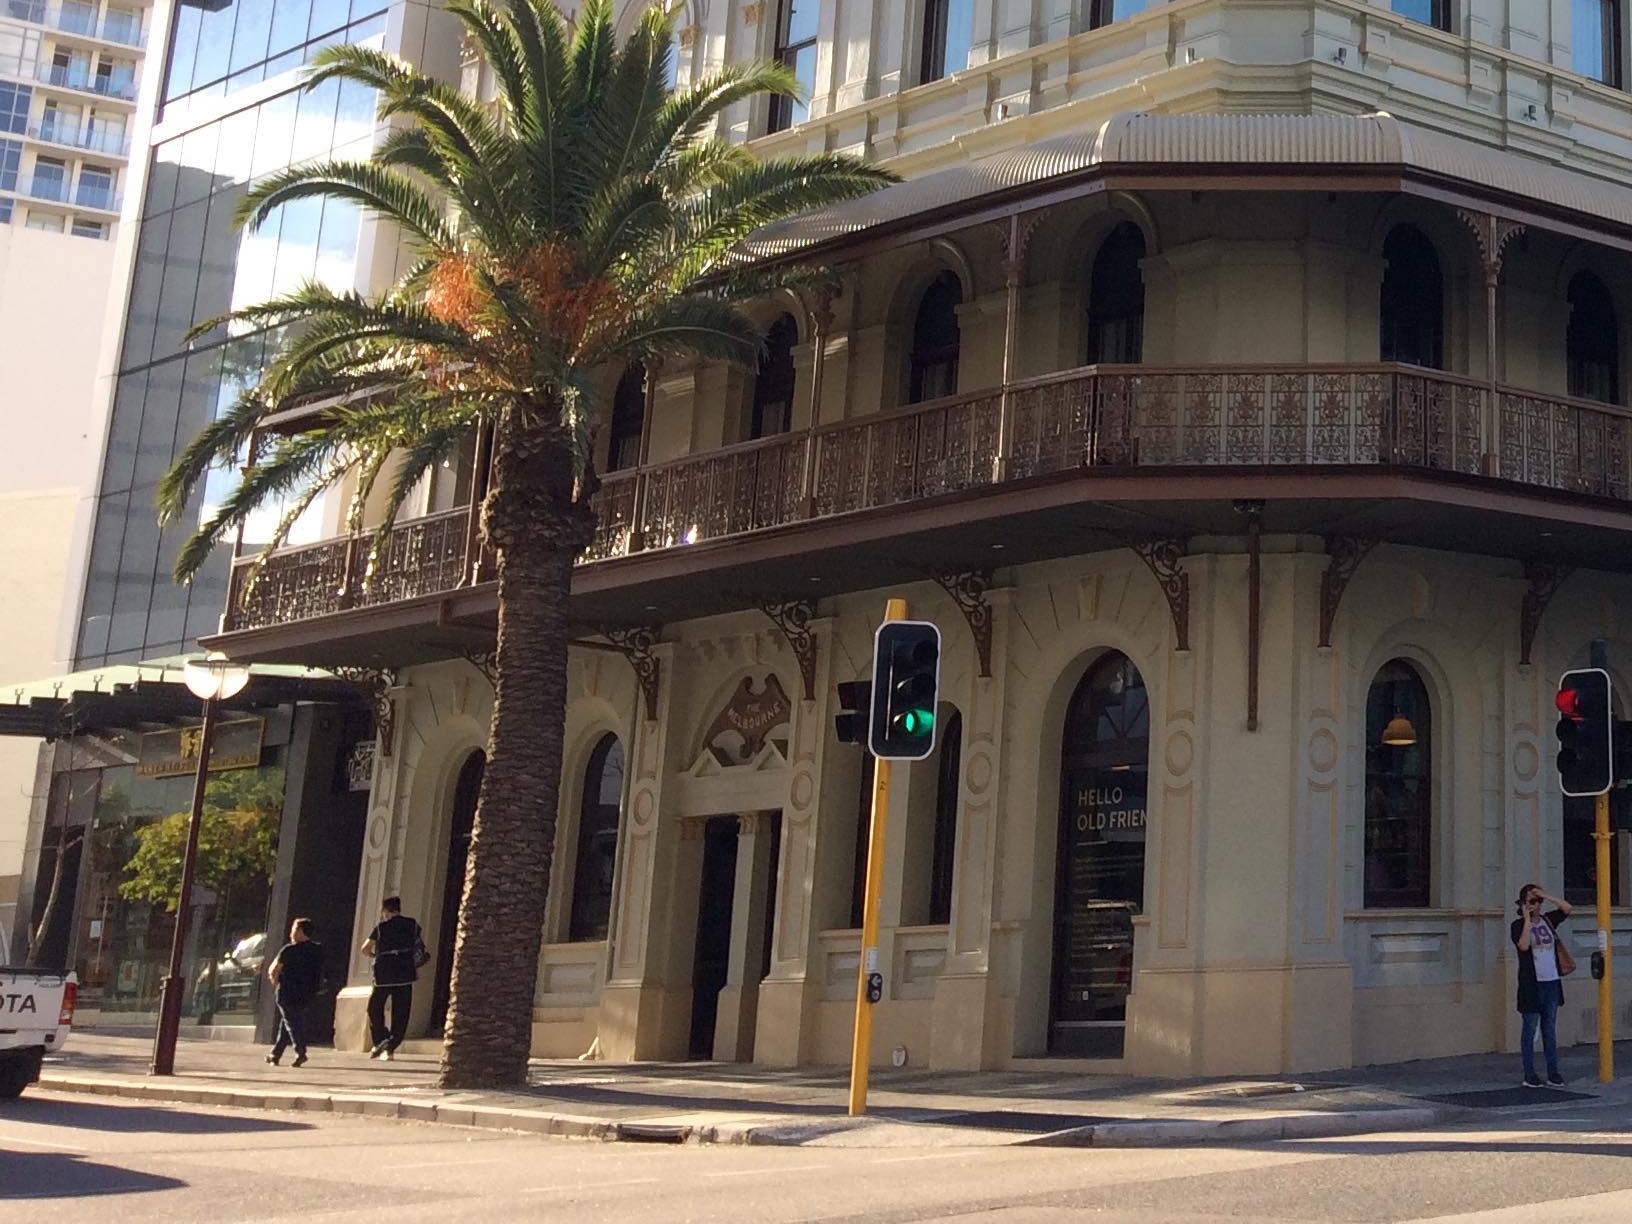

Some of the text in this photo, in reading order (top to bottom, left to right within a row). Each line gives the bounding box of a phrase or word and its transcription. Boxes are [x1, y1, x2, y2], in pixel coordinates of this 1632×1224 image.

[727, 701, 783, 729] MELBOURNE
[1078, 787, 1123, 806] HELLO
[1077, 809, 1147, 831] OLD FRIEN
[1531, 925, 1553, 946] 19
